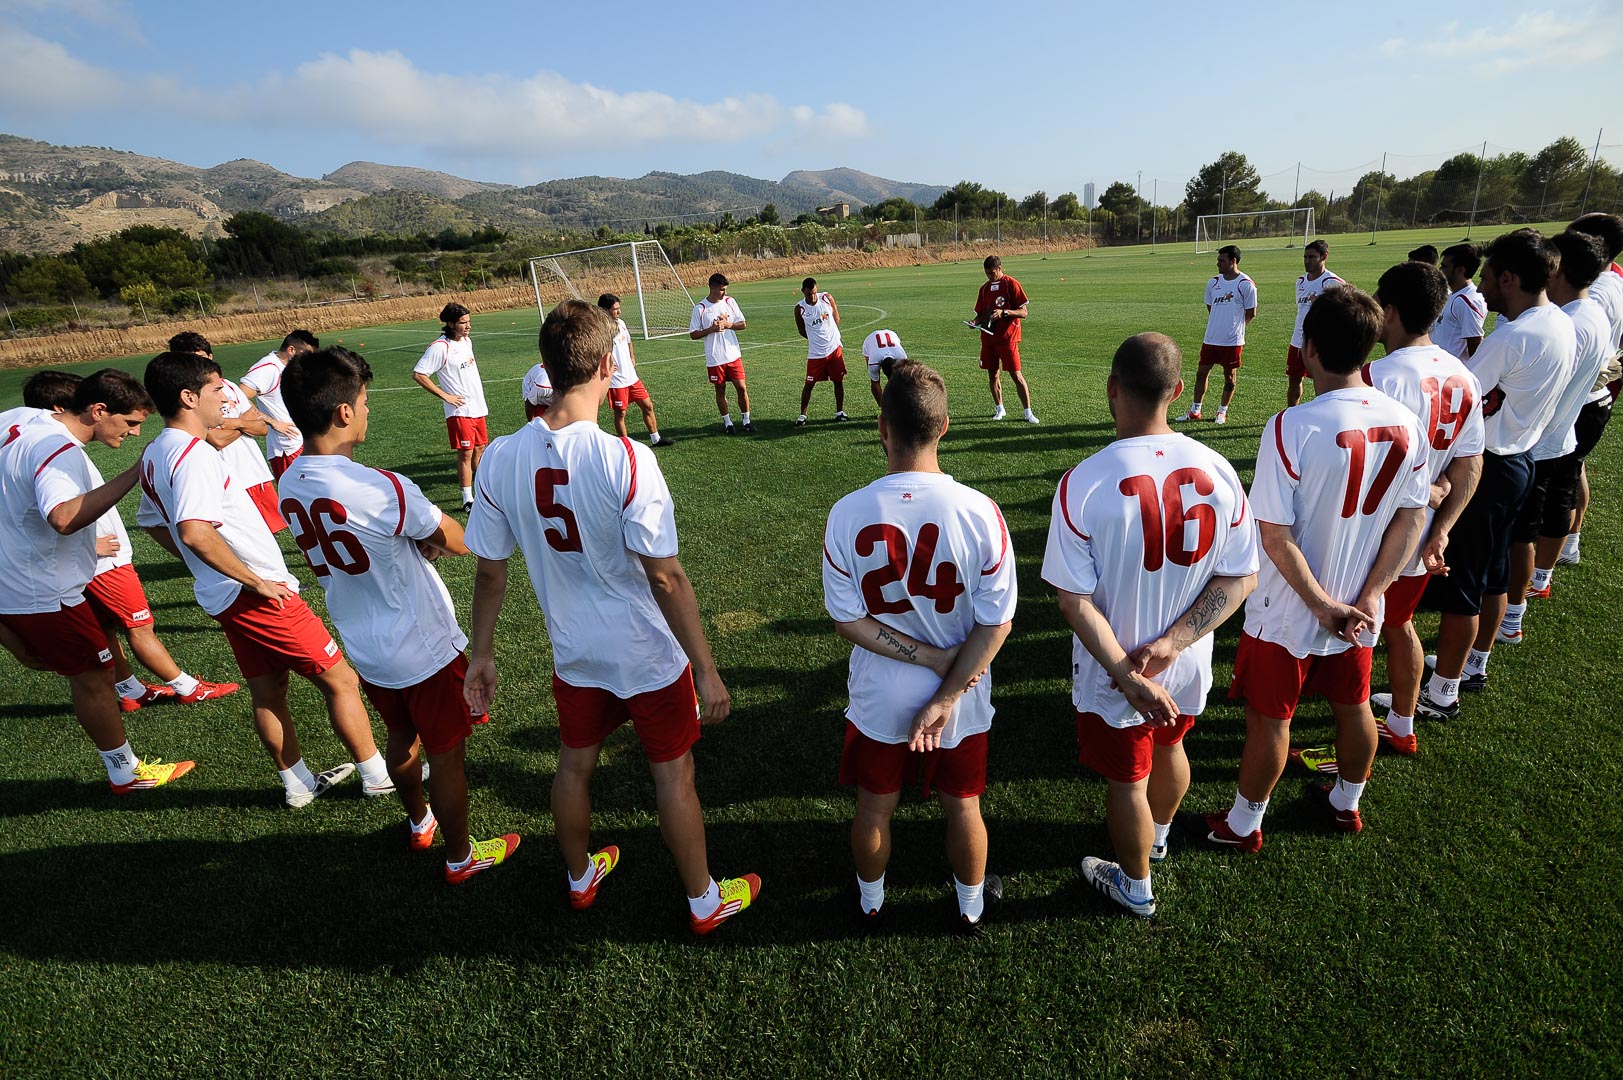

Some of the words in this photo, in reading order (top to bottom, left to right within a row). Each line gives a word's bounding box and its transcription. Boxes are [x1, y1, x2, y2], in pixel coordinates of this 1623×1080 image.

[875, 333, 896, 349] 11
[1420, 375, 1473, 450] 19
[535, 467, 583, 553] 5
[1336, 425, 1409, 519] 17
[280, 498, 370, 576] 26
[1119, 467, 1216, 572] 16
[854, 522, 965, 615] 24
